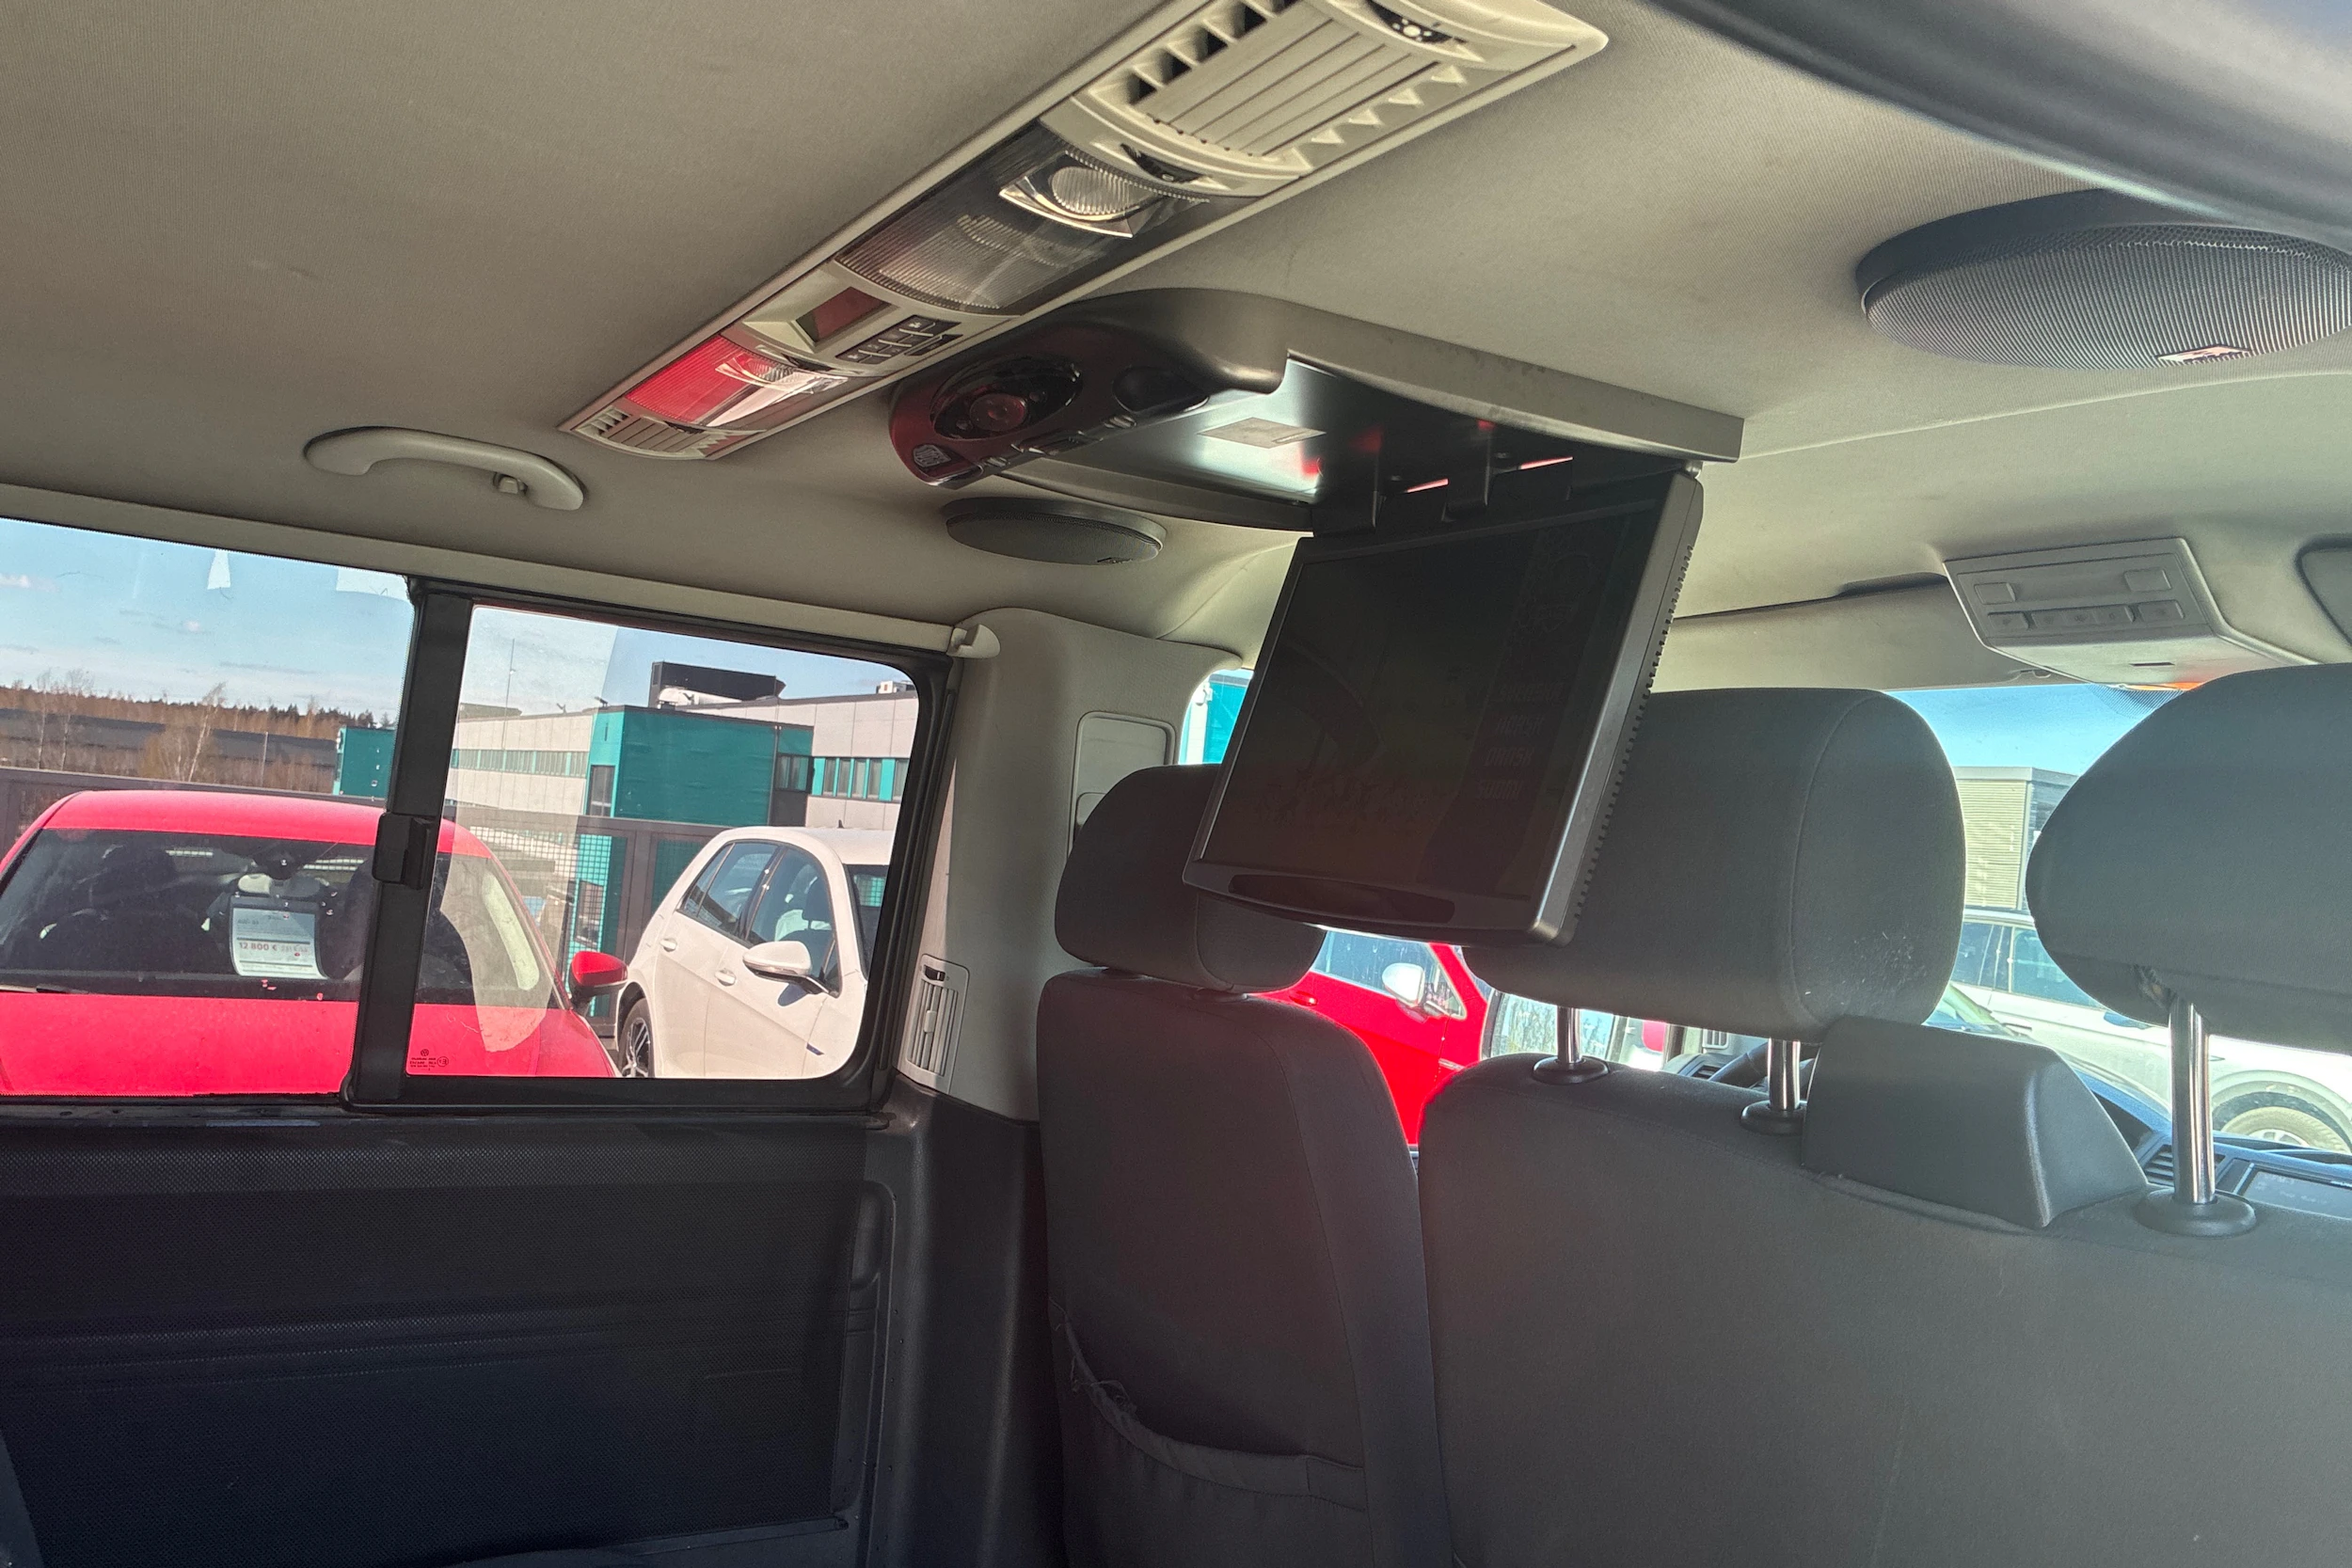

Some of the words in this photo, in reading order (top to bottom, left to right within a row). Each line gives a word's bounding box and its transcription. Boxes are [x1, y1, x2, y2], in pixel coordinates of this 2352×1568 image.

[1484, 746, 1534, 768] DANSK
[1474, 778, 1524, 800] SUOMI
[239, 942, 248, 950] 12
[250, 942, 269, 951] 800
